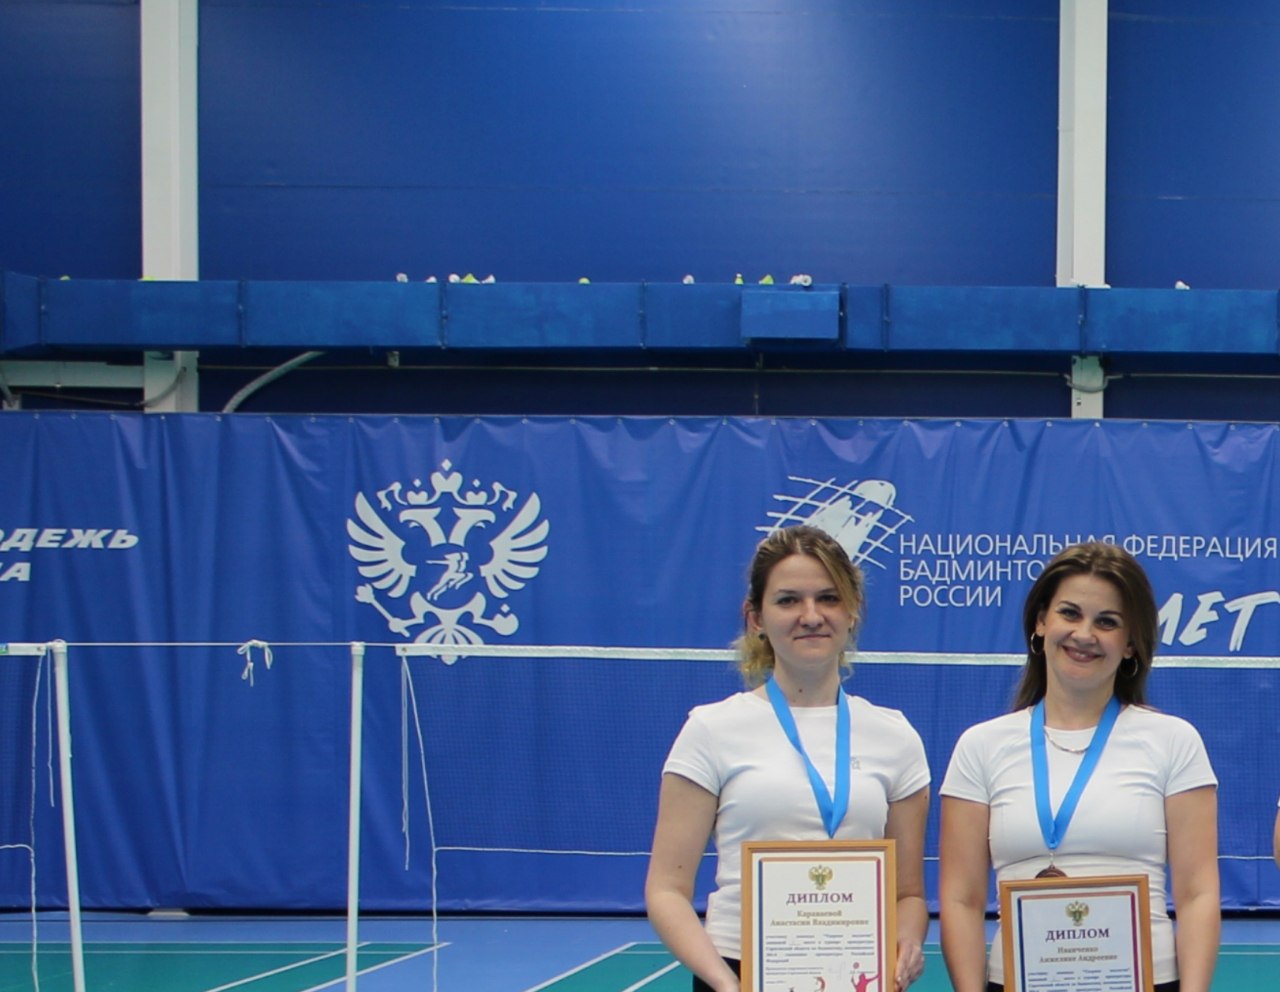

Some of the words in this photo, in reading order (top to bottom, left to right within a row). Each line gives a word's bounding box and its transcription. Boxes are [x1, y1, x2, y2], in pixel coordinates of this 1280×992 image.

[0, 528, 139, 552] ДЕЖЬ
[1123, 533, 1278, 562] ФЕДЕРАЦИЯ
[900, 559, 1047, 585] БАДМИНТО
[900, 585, 1002, 608] РОССИИ
[786, 893, 854, 905] ДИПЛОМ
[1045, 928, 1110, 942] ДИПЛОМ
